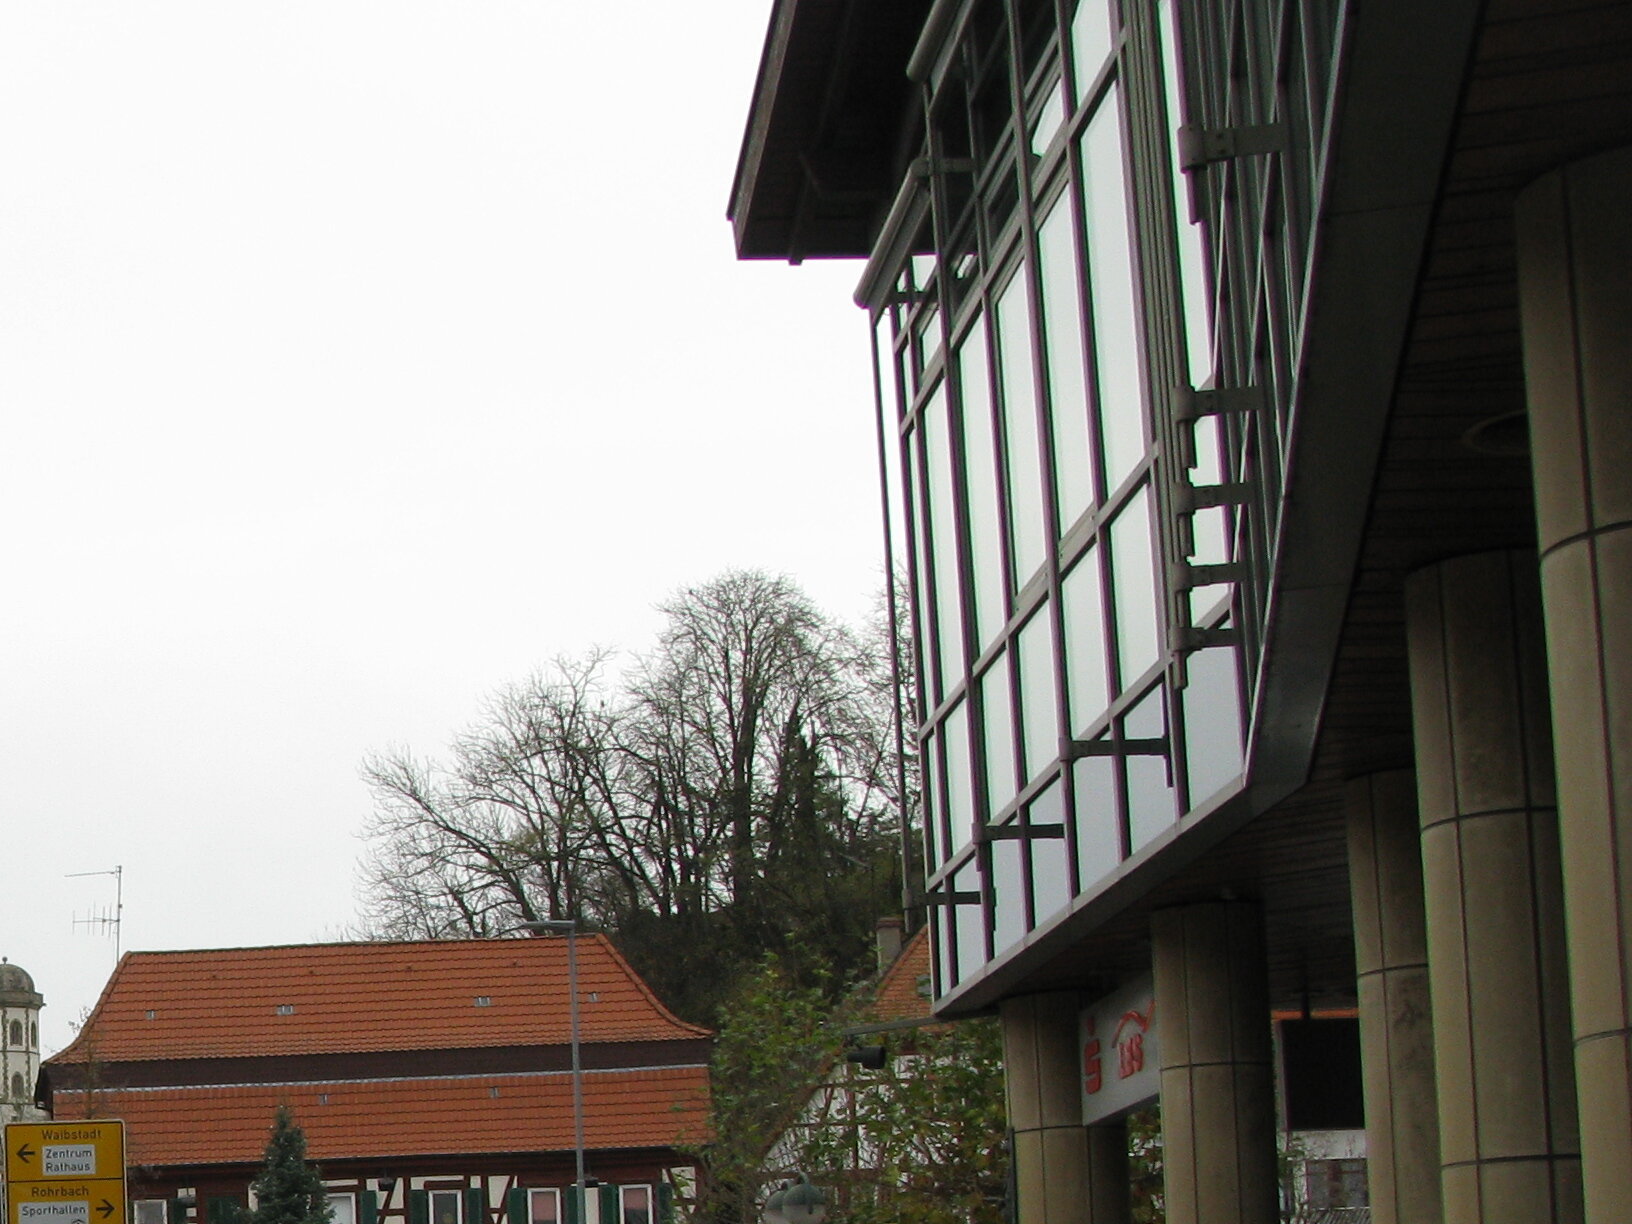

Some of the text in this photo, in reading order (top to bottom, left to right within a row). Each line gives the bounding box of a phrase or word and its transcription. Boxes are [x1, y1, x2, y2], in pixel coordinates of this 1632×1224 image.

[41, 1129, 102, 1140] Waibstadt
[45, 1149, 93, 1159] Zentrum
[45, 1162, 91, 1173] Rathaus
[31, 1186, 90, 1197] Rohrbach
[22, 1205, 87, 1218] Sporthallen
